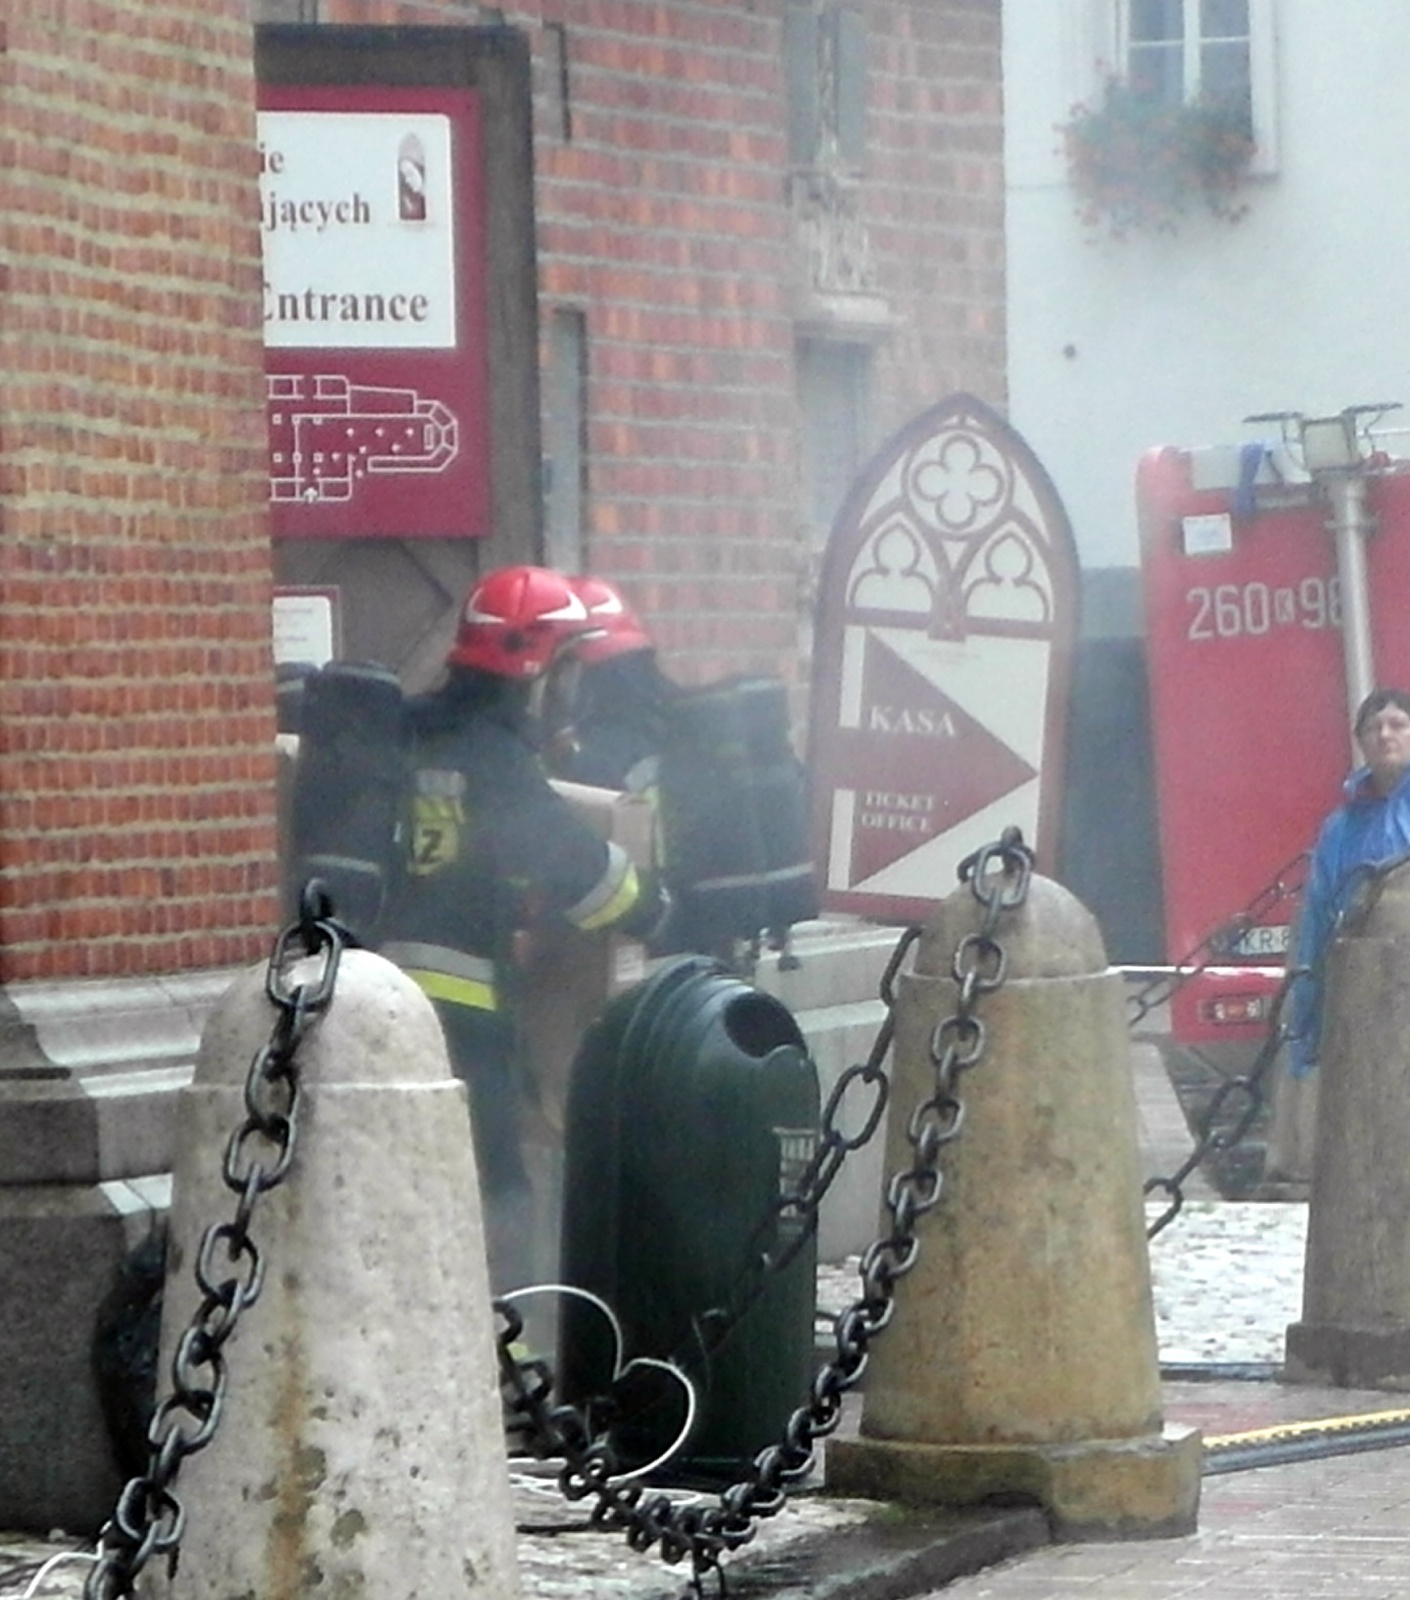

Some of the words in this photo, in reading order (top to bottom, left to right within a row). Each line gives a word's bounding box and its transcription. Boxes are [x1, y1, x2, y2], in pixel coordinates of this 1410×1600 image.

[868, 704, 957, 737] KASA
[864, 790, 935, 812] TICKET
[860, 812, 932, 833] OFFICE
